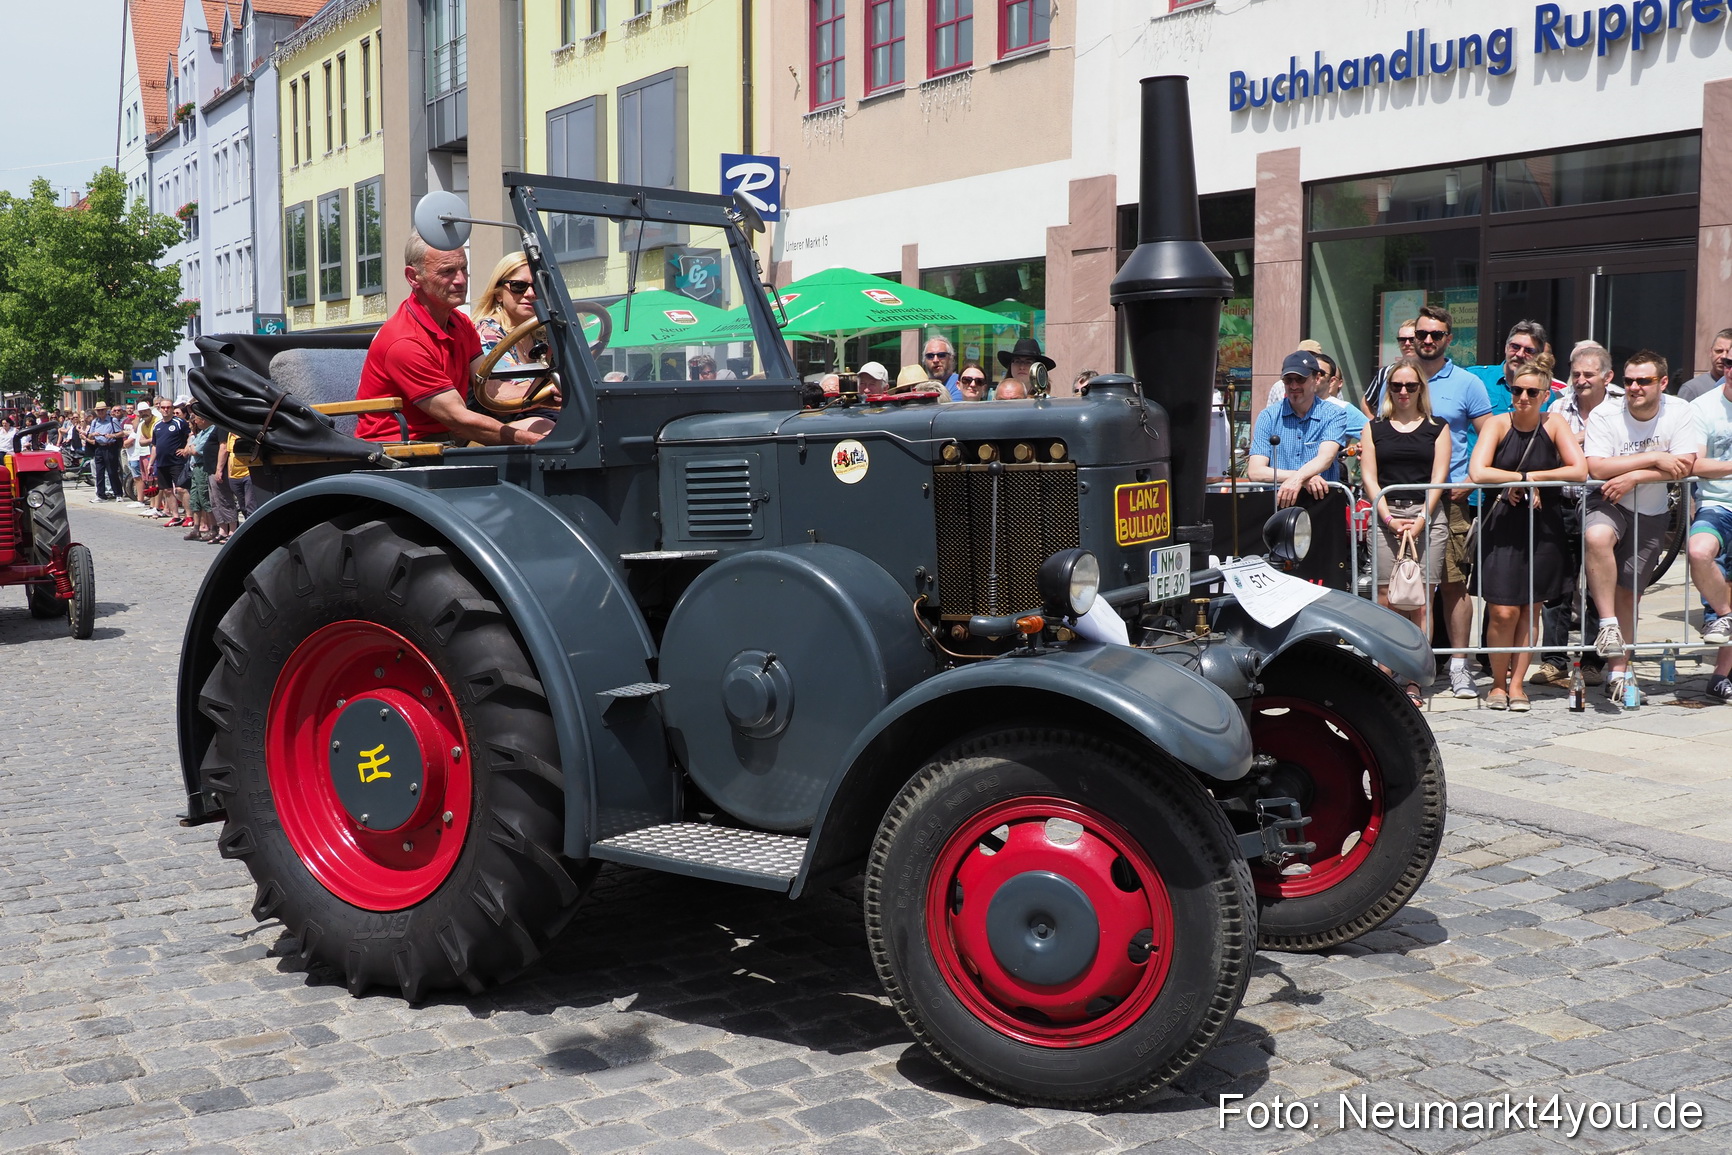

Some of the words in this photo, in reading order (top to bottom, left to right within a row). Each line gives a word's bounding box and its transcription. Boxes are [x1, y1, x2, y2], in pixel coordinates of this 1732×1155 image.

[1229, 27, 1515, 112] Buchhandlung
[785, 240, 804, 252] Unterer
[805, 236, 820, 249] Markt
[822, 234, 829, 247] 15
[687, 263, 709, 290] G2
[866, 313, 958, 323] Lammsbräu
[869, 307, 935, 315] Neumarkter
[1221, 305, 1250, 316] Grillen
[1129, 487, 1160, 512] LANZ
[1119, 512, 1168, 541] BULLDOG
[1160, 551, 1175, 574] NM
[1157, 576, 1170, 599] EE
[1173, 573, 1185, 596] 39
[1249, 572, 1276, 589] 571
